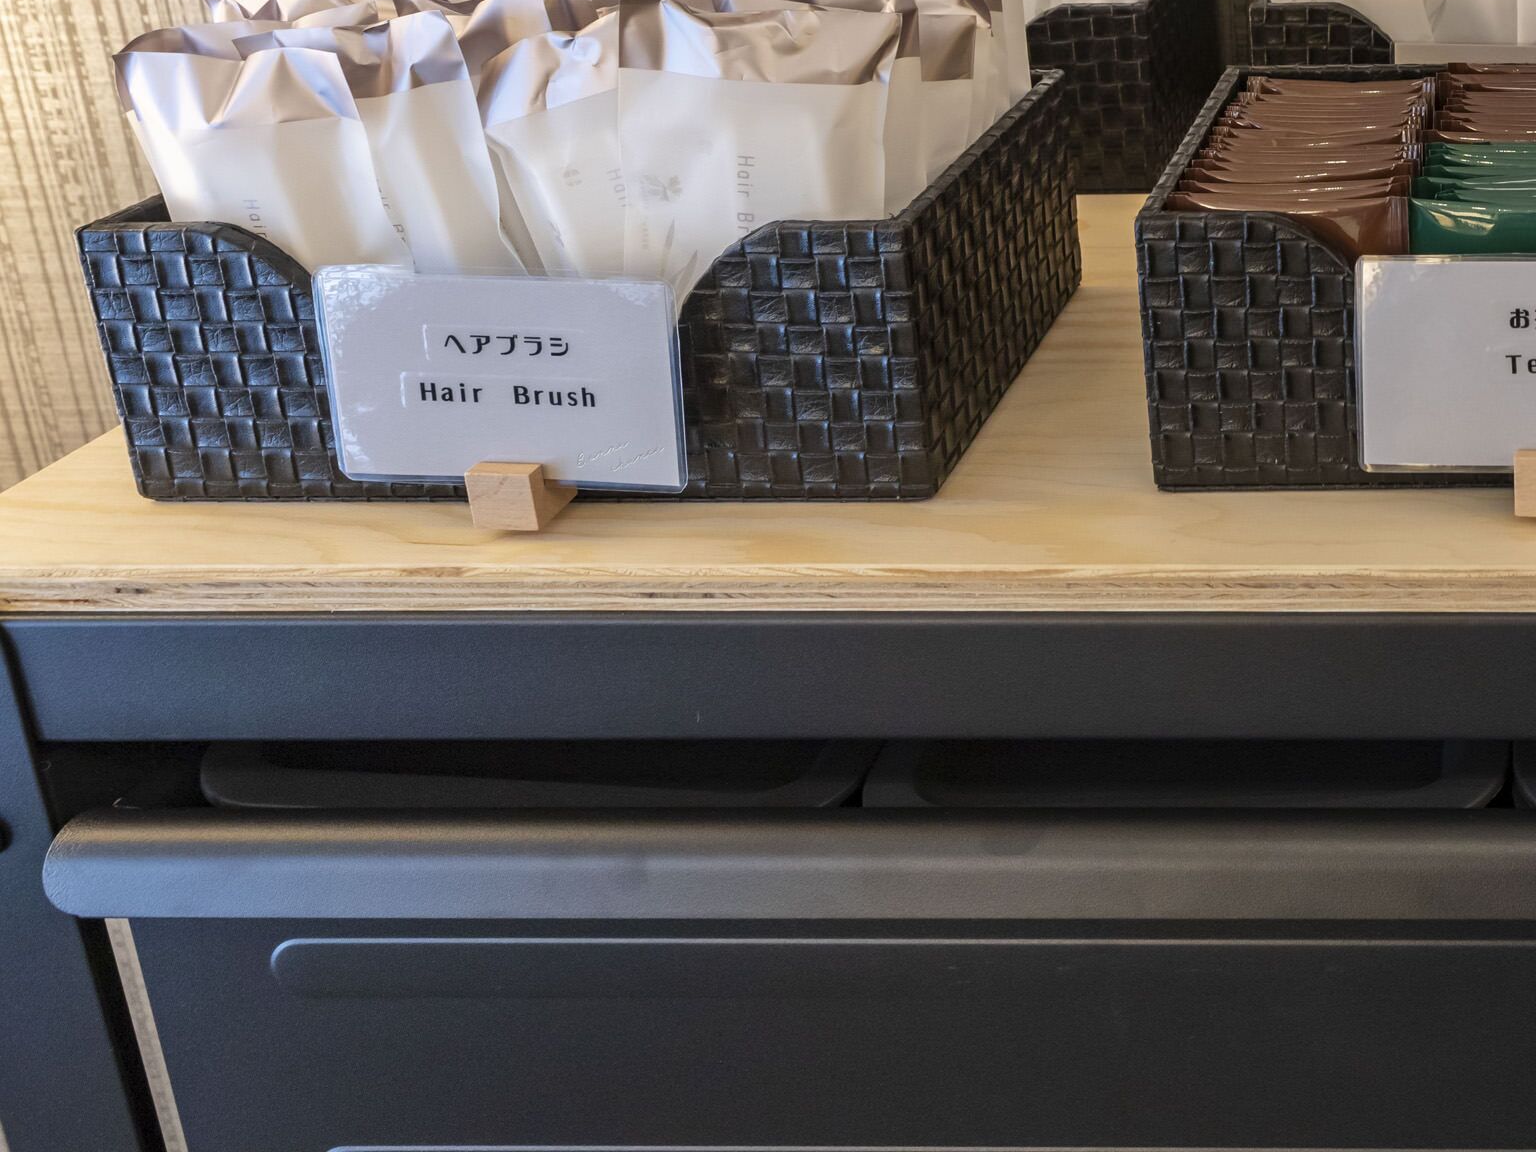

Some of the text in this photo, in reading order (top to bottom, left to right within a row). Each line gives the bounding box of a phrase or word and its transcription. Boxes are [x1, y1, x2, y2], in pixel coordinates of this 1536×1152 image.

[736, 154, 755, 198] Hair
[443, 333, 570, 357] ヘアブラシ
[419, 381, 597, 408] Hair Brush
